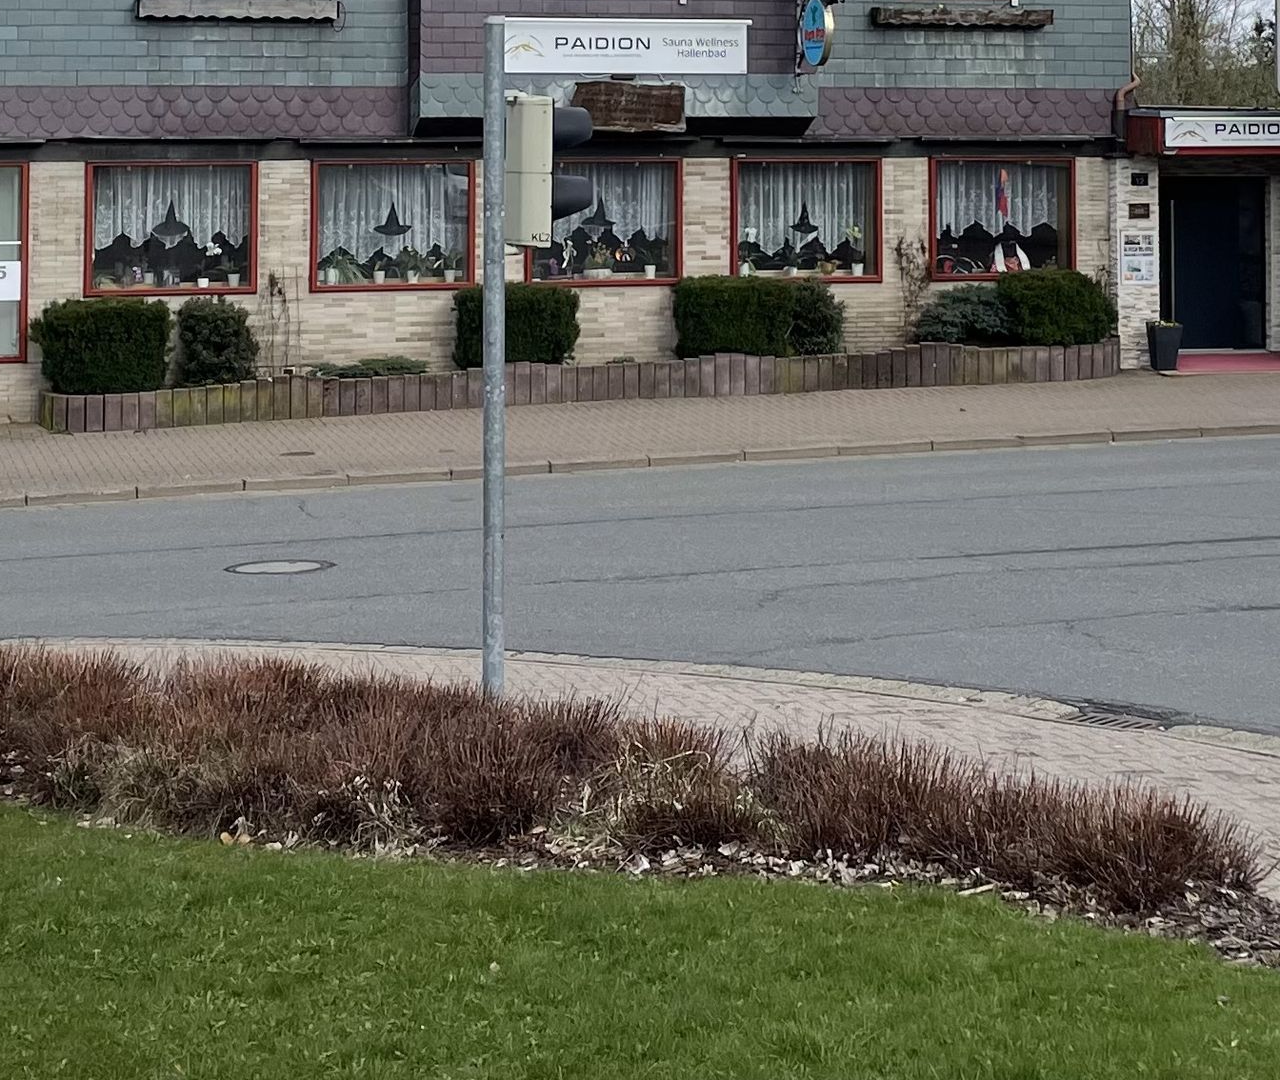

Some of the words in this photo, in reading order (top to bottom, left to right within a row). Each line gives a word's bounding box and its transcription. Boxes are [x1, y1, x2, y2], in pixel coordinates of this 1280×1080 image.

[555, 37, 651, 50] PAIDION
[662, 37, 694, 47] Sauna
[695, 37, 739, 48] Wellness
[677, 48, 727, 58] Hallenbad
